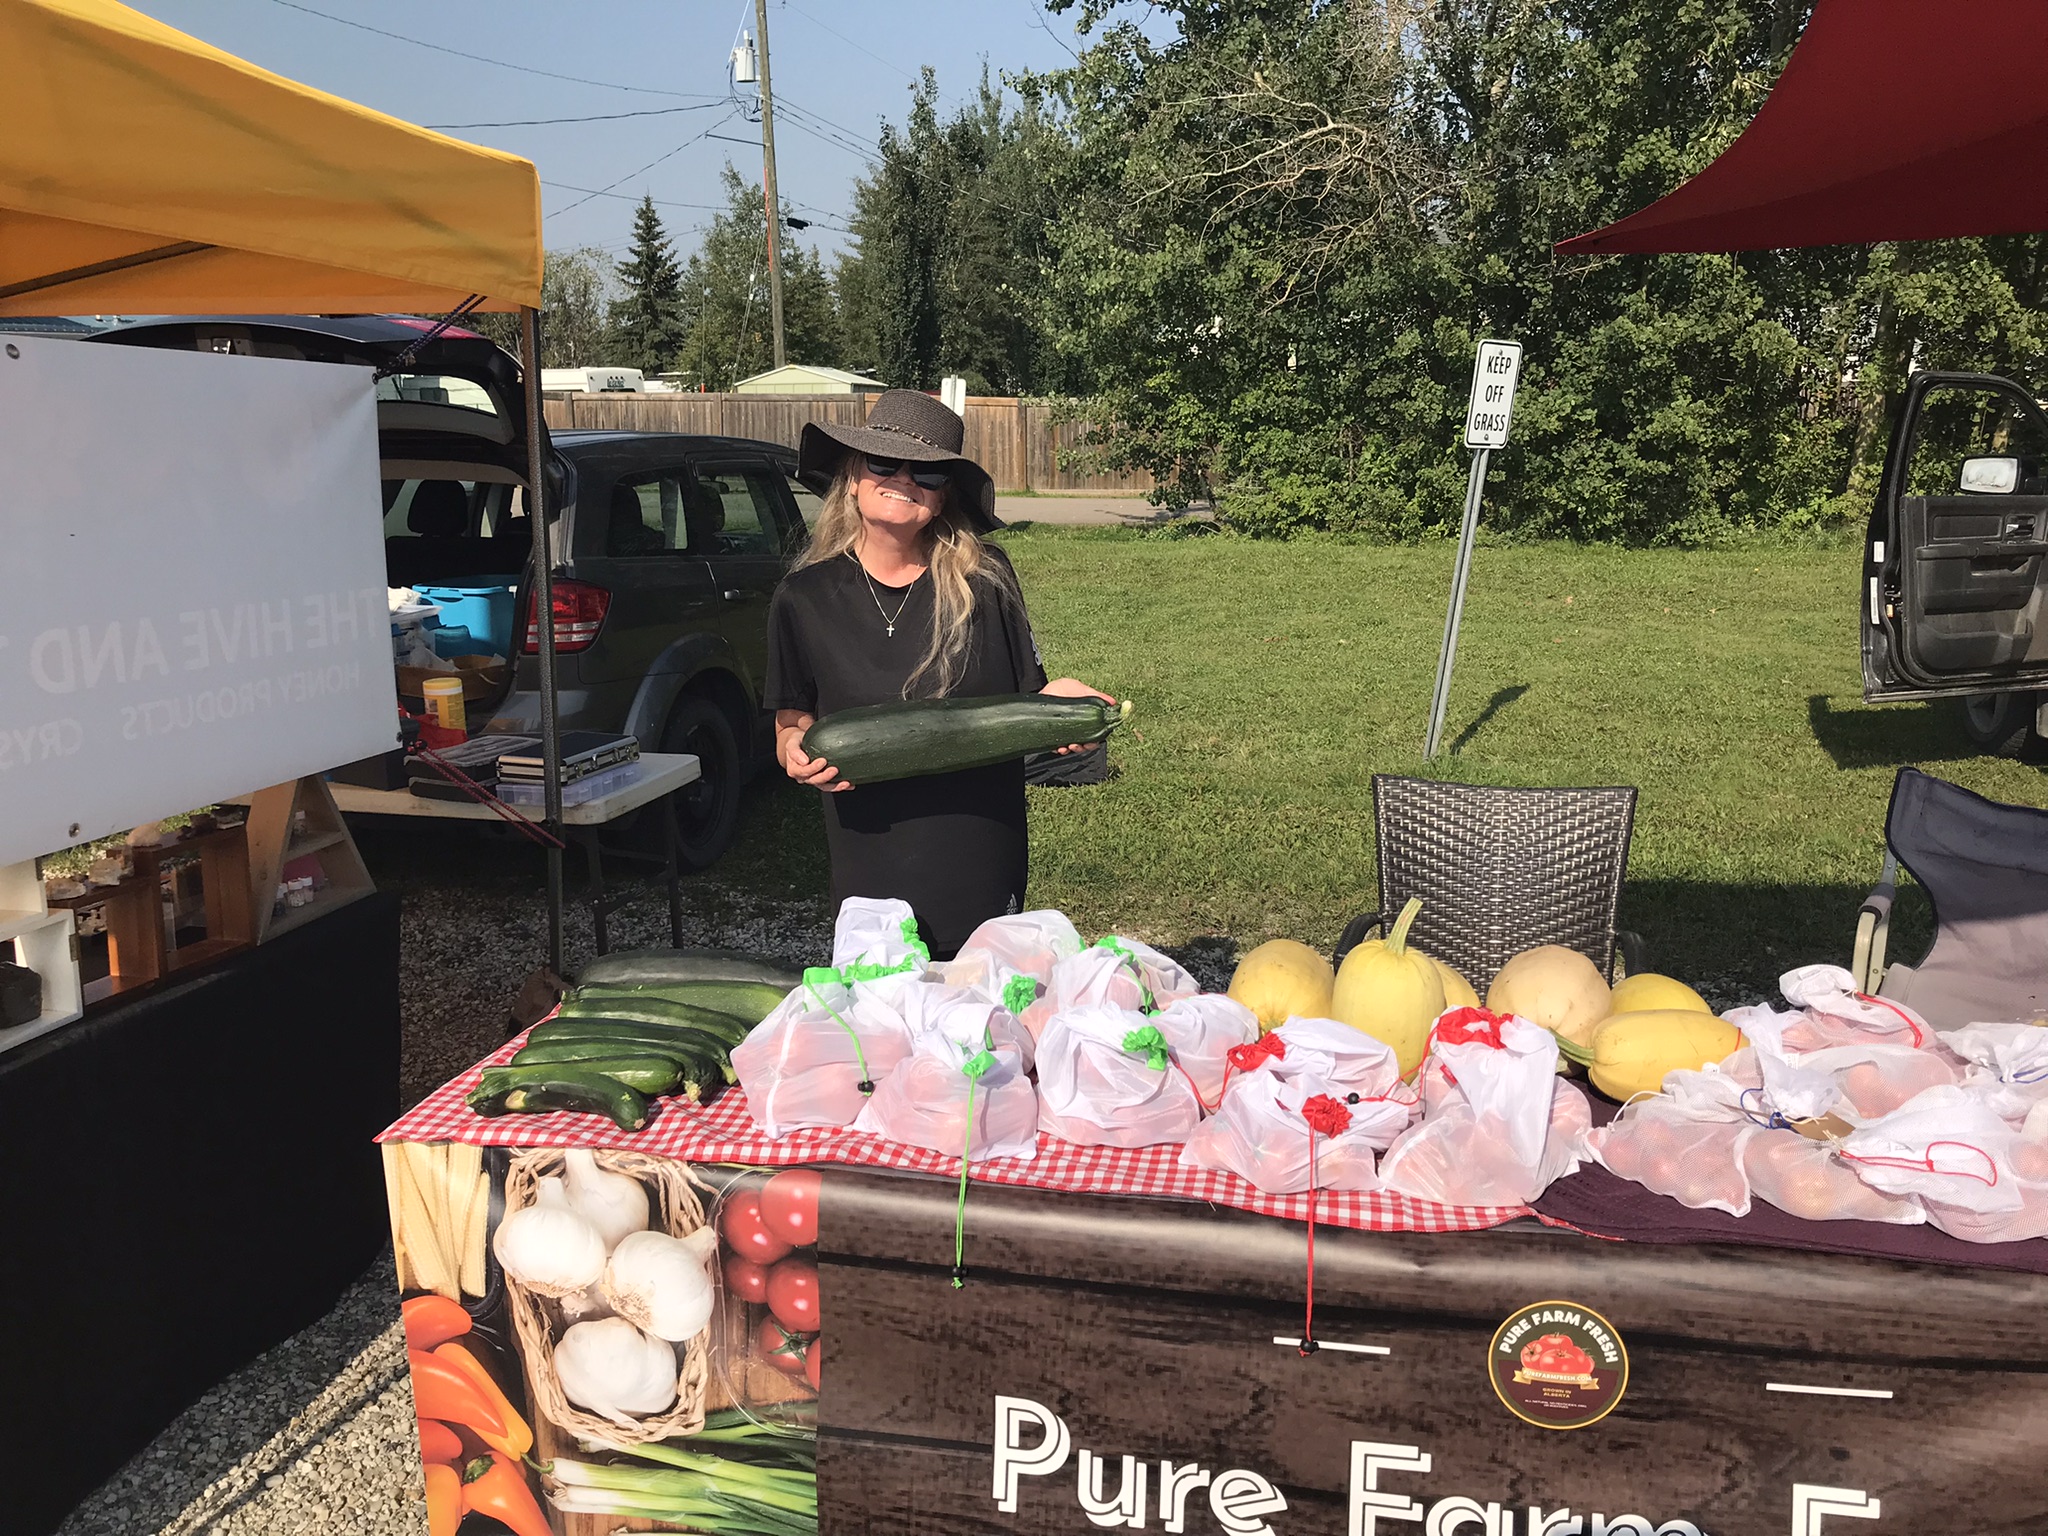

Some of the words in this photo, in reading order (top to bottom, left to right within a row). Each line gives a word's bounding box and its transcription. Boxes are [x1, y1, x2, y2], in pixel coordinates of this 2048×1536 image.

[1486, 355, 1512, 375] KEEP
[1485, 384, 1505, 403] OFF
[1474, 413, 1506, 432] GRASS
[1499, 1318, 1532, 1354] PURE
[1531, 1310, 1581, 1327] FARM
[1582, 1319, 1619, 1363] FRESH
[993, 1395, 1288, 1536] Pure
